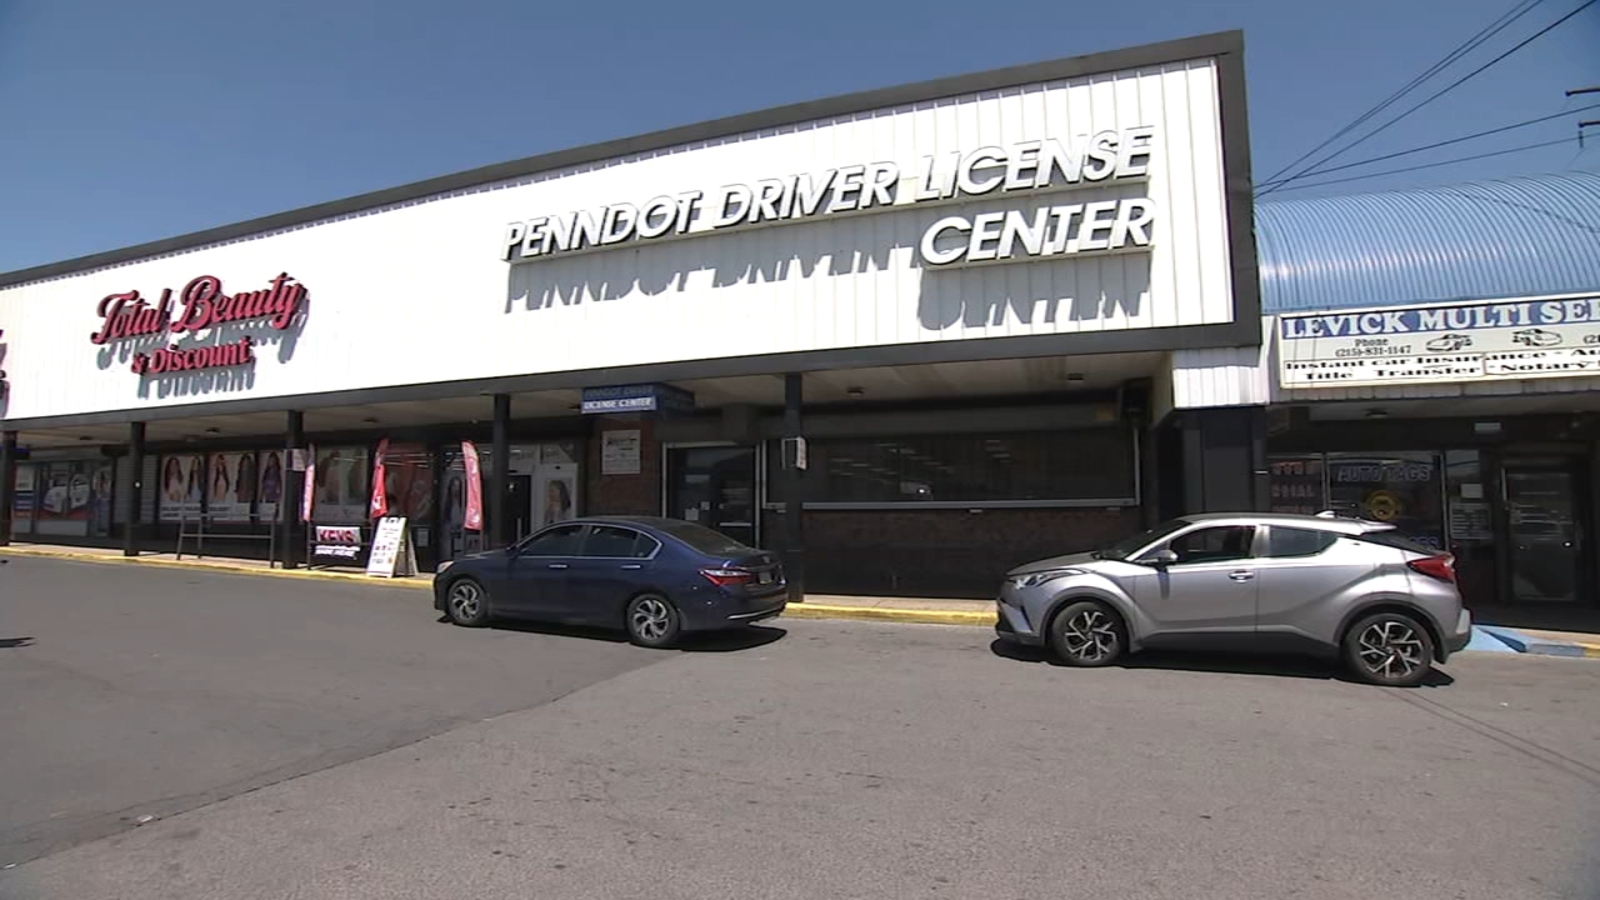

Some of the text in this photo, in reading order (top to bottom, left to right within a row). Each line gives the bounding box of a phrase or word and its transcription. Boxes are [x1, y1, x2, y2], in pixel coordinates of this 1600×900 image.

[500, 125, 1154, 261] PENNDOT DRIVER LICENSE
[920, 198, 1156, 266] CENTER
[91, 272, 306, 344] Total Beauty
[1284, 312, 1410, 337] LEVICK
[1418, 303, 1531, 331] MULTI
[149, 336, 252, 374] Discount
[1354, 338, 1389, 347] Phone
[1286, 359, 1365, 370] Instant
[1304, 371, 1353, 380] Title
[1374, 366, 1481, 377] Transfer
[1500, 360, 1596, 371] Notary
[618, 397, 652, 407] CENTER
